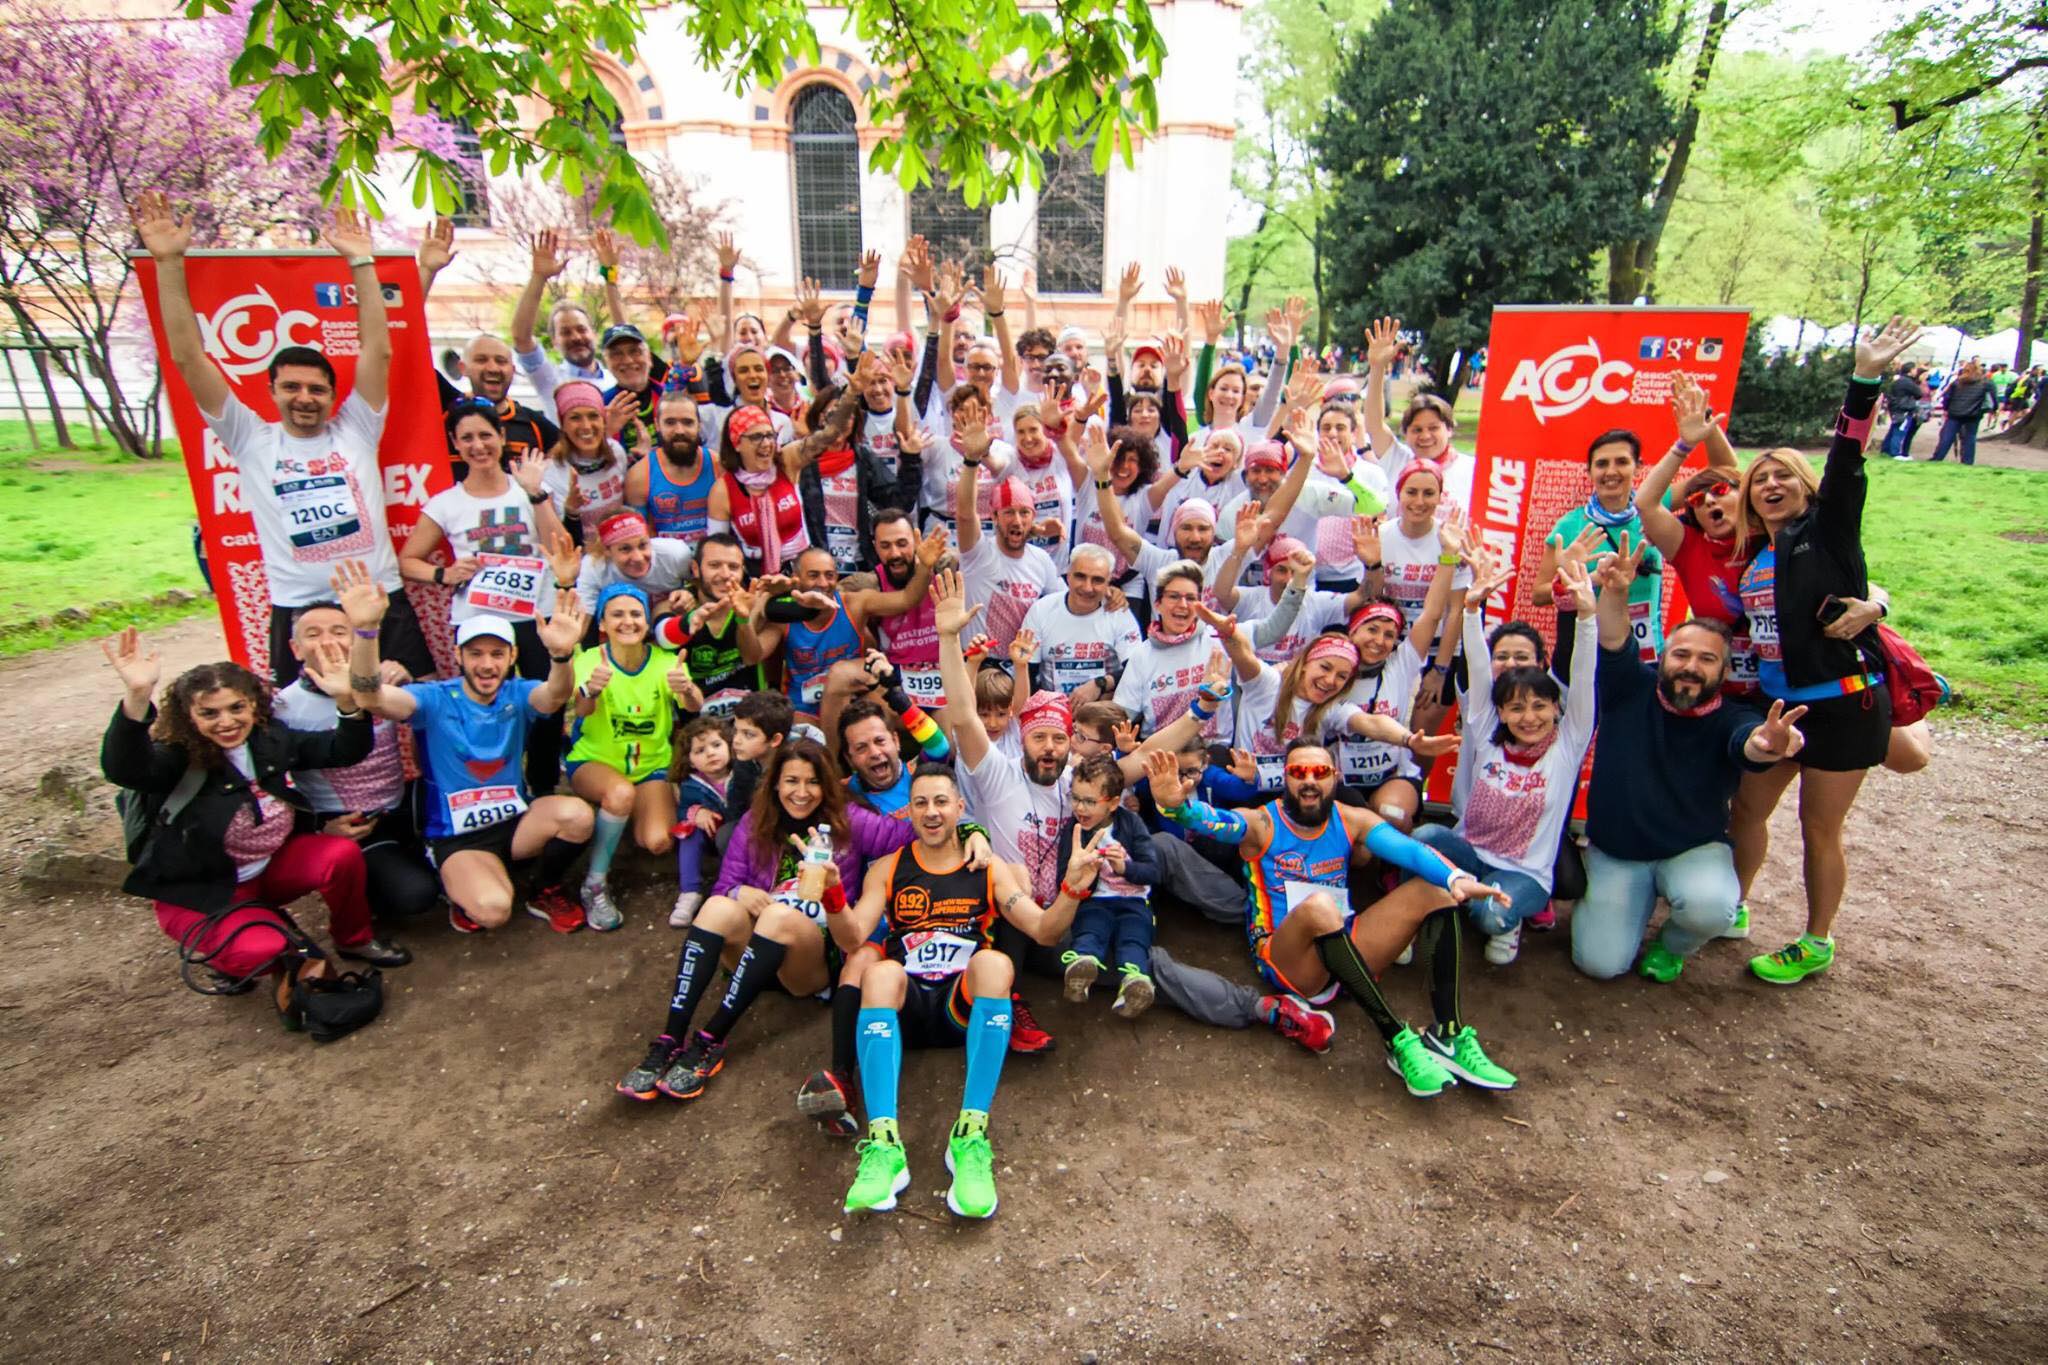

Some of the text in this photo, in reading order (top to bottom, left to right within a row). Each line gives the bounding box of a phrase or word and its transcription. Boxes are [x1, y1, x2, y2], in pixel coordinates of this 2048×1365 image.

[1484, 456, 1526, 526] LUCE
[481, 570, 535, 591] F683
[907, 676, 943, 690] 3199
[1350, 752, 1391, 769] 1211A
[463, 803, 518, 828] 4819
[917, 942, 962, 963] 1917
